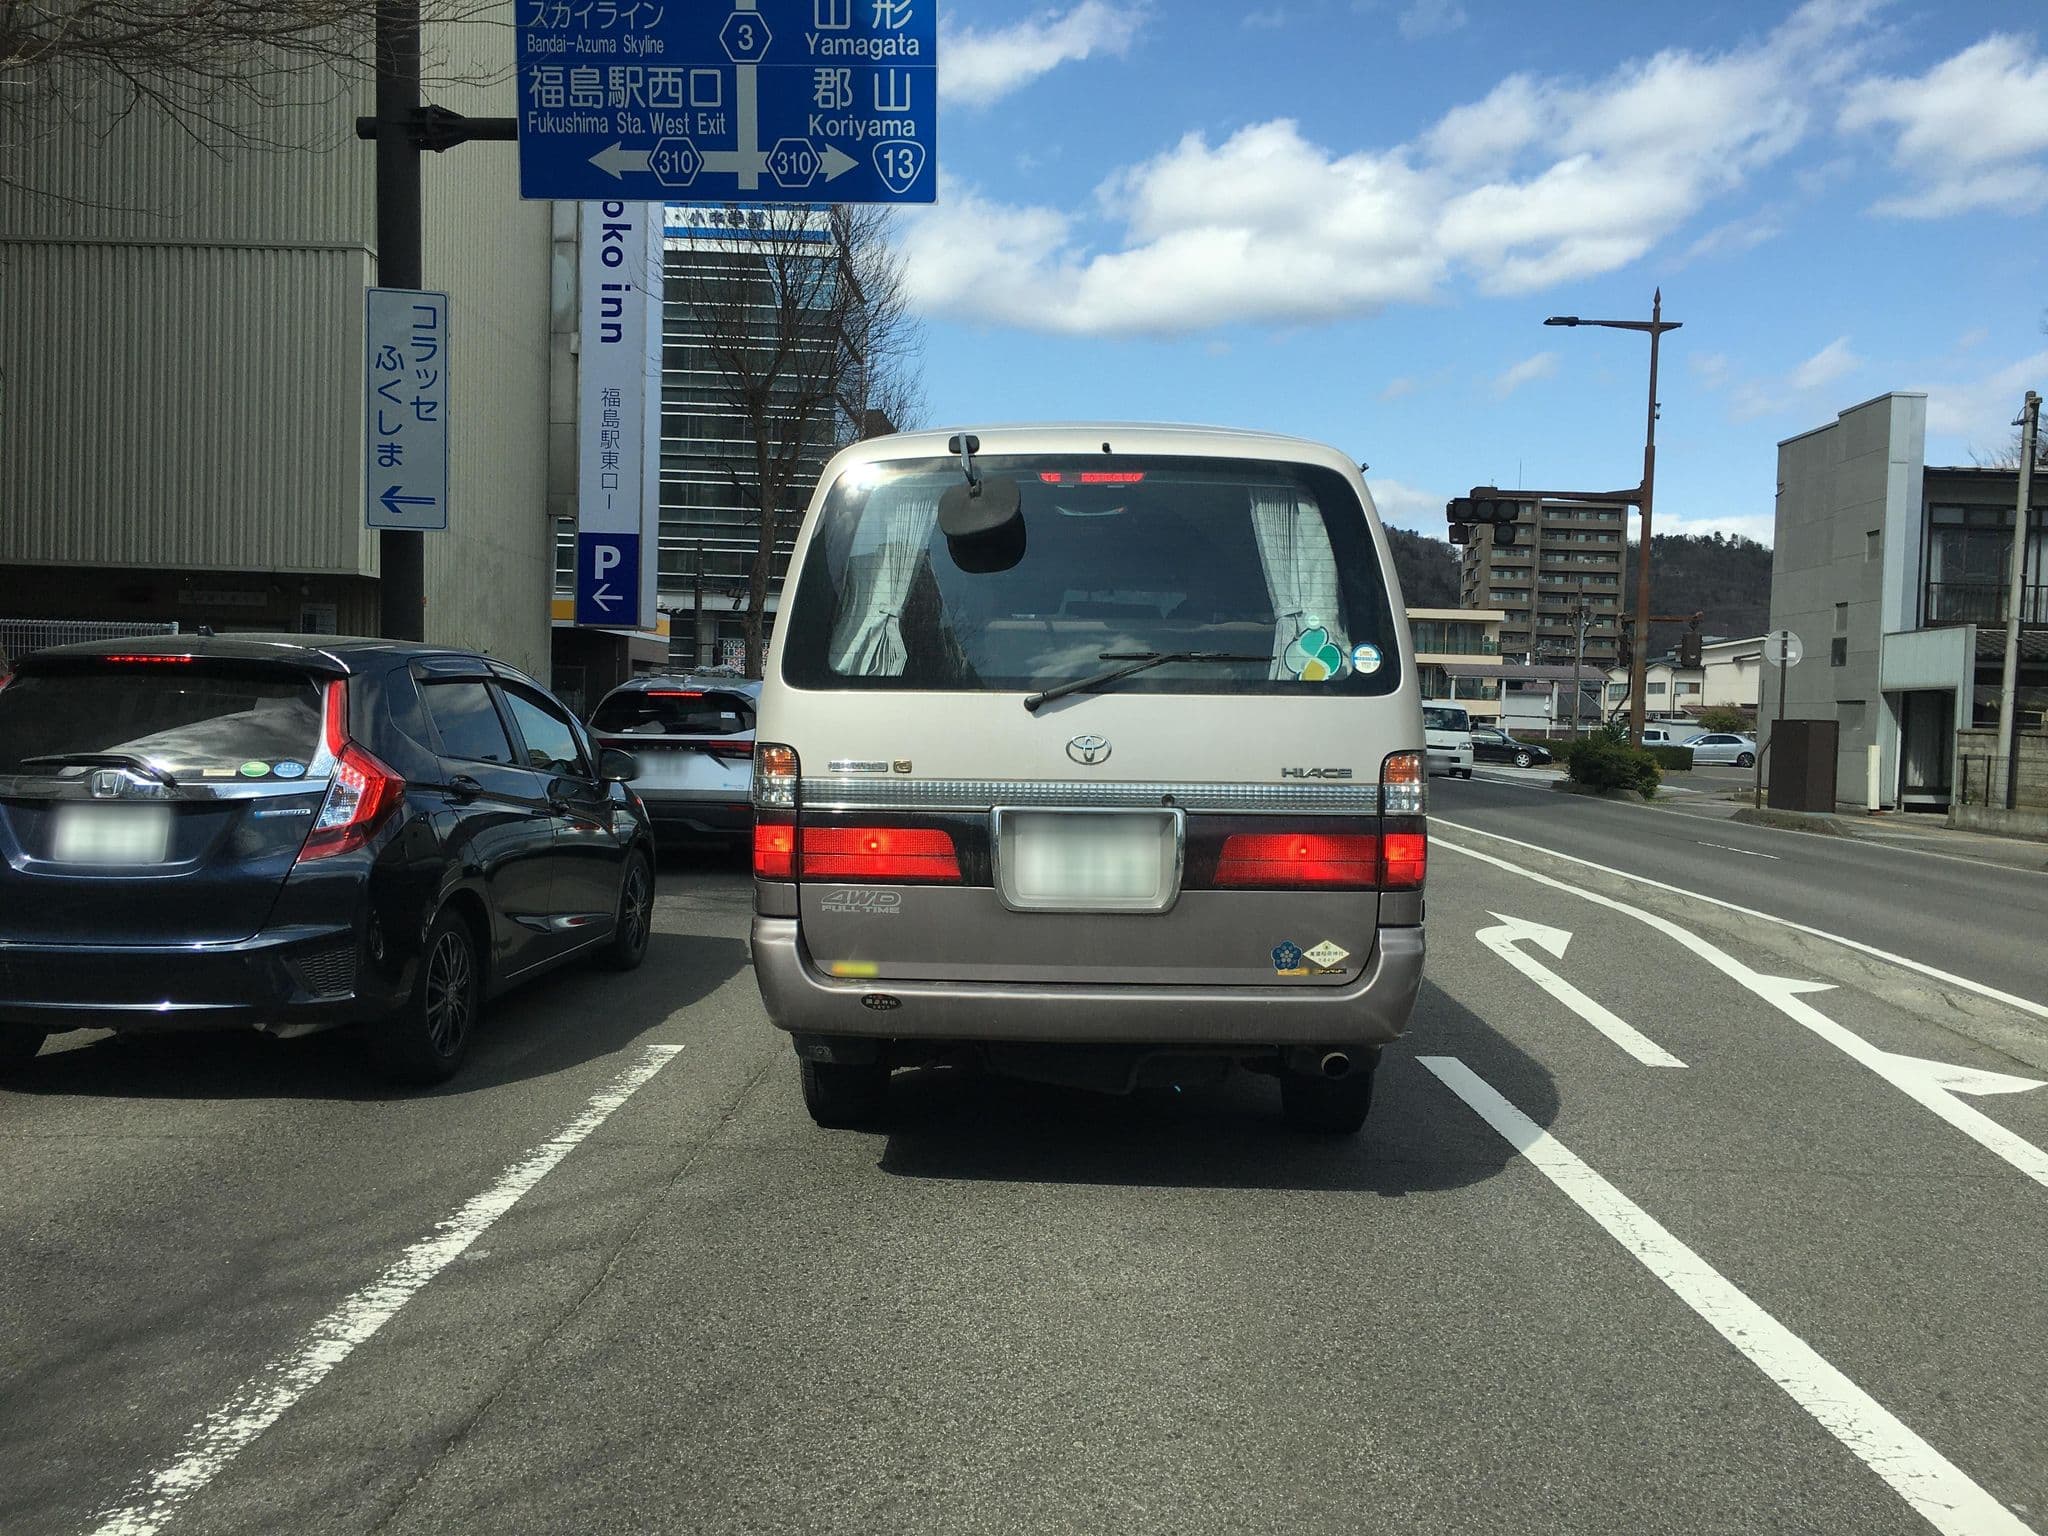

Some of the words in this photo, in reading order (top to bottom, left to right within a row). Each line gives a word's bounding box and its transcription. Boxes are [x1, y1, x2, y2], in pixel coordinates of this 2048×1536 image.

[529, 1, 664, 29] スカイライン
[814, 0, 913, 29] 山形
[527, 34, 617, 53] Bandai-Azuma
[623, 34, 665, 58] Skyline
[738, 24, 754, 51] 3
[805, 33, 920, 60] Yamagata
[528, 65, 722, 109] 福島駅西口
[813, 68, 911, 111] 郡山
[528, 111, 609, 134] Fukushima
[617, 111, 646, 134] Sta.
[649, 112, 690, 135] West
[698, 112, 726, 135] Exit
[809, 114, 916, 141] Koriyama
[659, 150, 693, 174] 310
[777, 151, 811, 175] 310
[883, 148, 914, 179] 13
[600, 284, 631, 343] inn
[410, 304, 438, 422] コラッセ
[375, 344, 404, 468] ふくしま
[594, 545, 621, 580] P
[1281, 767, 1353, 779] HIACE
[820, 889, 902, 906] 4WD
[821, 905, 860, 913] FULL
